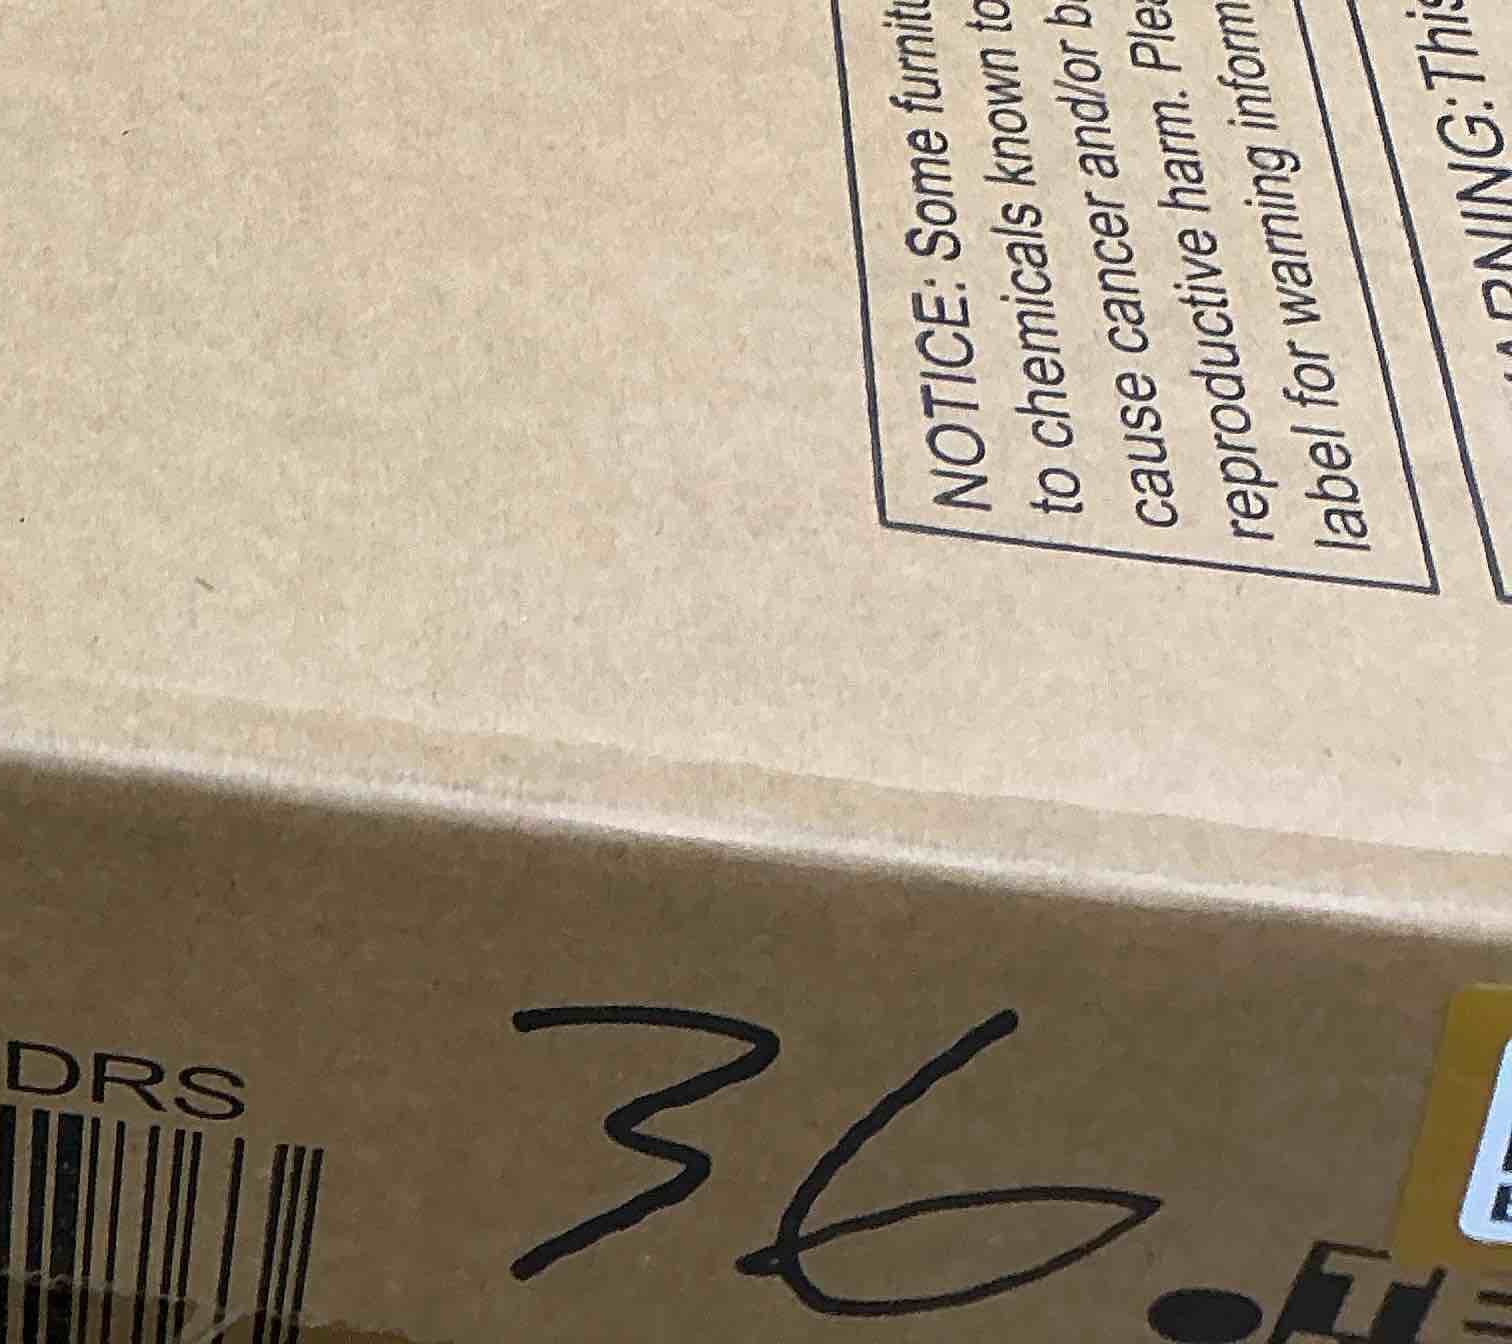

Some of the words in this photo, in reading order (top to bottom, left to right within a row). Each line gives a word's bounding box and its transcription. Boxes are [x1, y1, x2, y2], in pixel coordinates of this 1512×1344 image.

[981, 47, 1037, 187] known
[1054, 39, 1120, 181] and/or
[1160, 89, 1210, 212] harm.
[905, 128, 961, 261] Some
[1243, 144, 1324, 327] warning
[990, 202, 1075, 450] chemicals
[1087, 191, 1150, 355] cancer
[911, 278, 992, 512] NOTICE:
[1171, 228, 1278, 542] reproductive
[1282, 340, 1339, 410] for
[1029, 469, 1084, 515] to
[1112, 372, 1180, 530] cause
[1290, 424, 1372, 553] label
[511, 1004, 1163, 1317] 36
